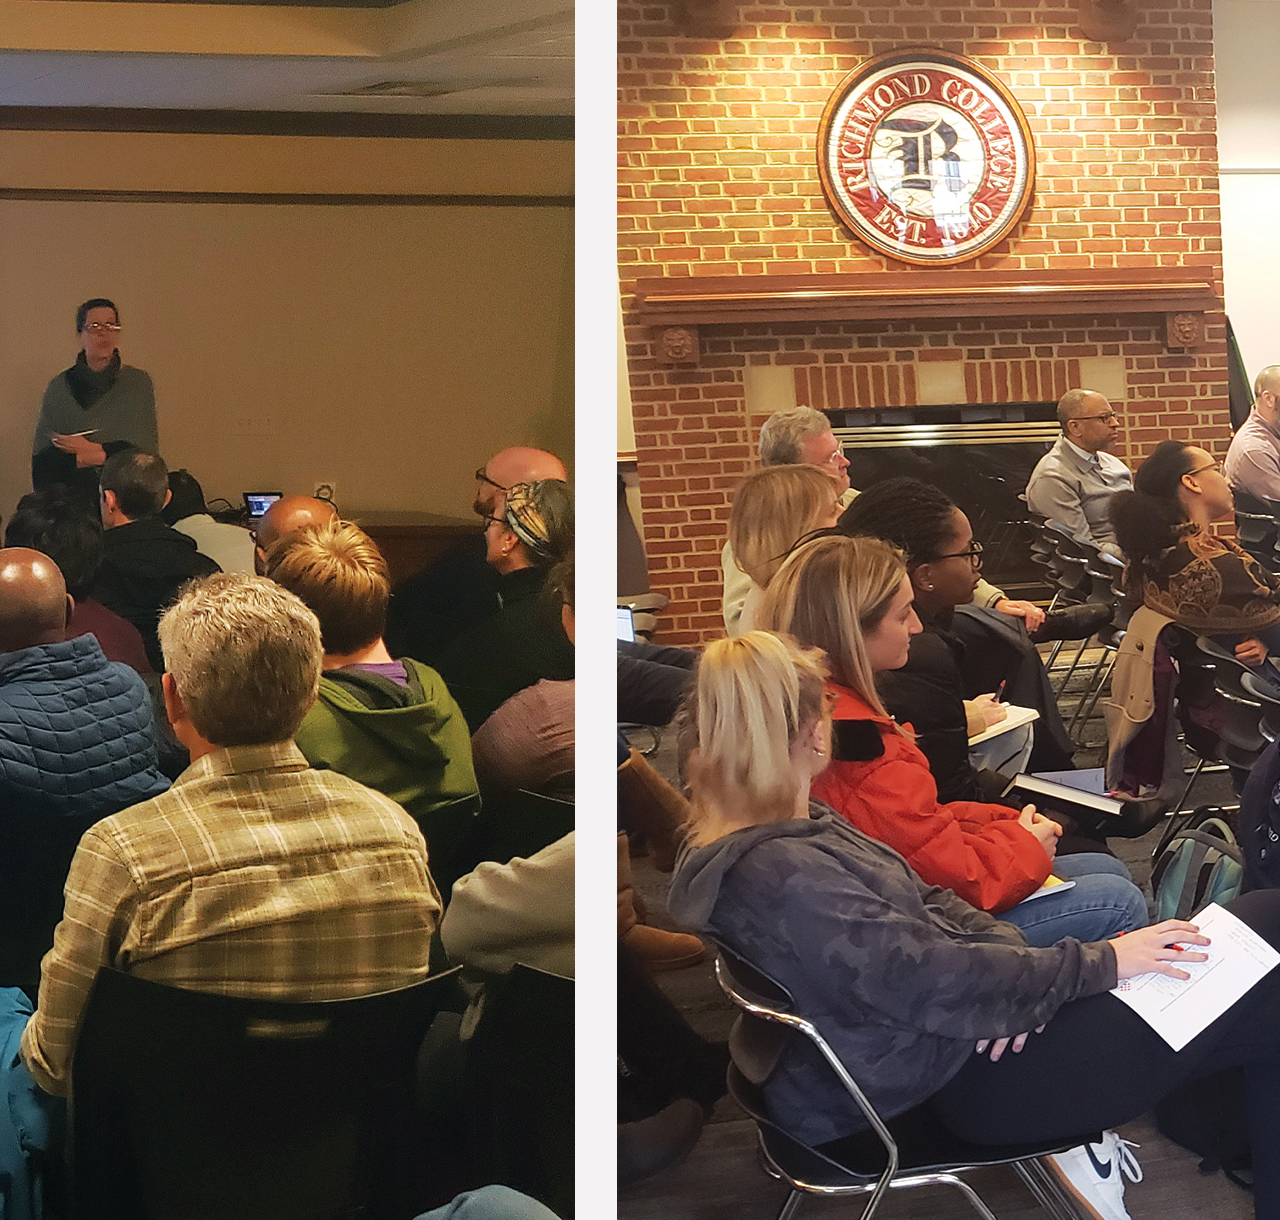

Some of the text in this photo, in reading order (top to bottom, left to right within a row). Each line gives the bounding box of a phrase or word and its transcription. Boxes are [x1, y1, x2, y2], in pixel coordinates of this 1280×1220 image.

[841, 73, 1016, 194] RICHMOND COLLEGE
[873, 201, 994, 245] EST. 1840
